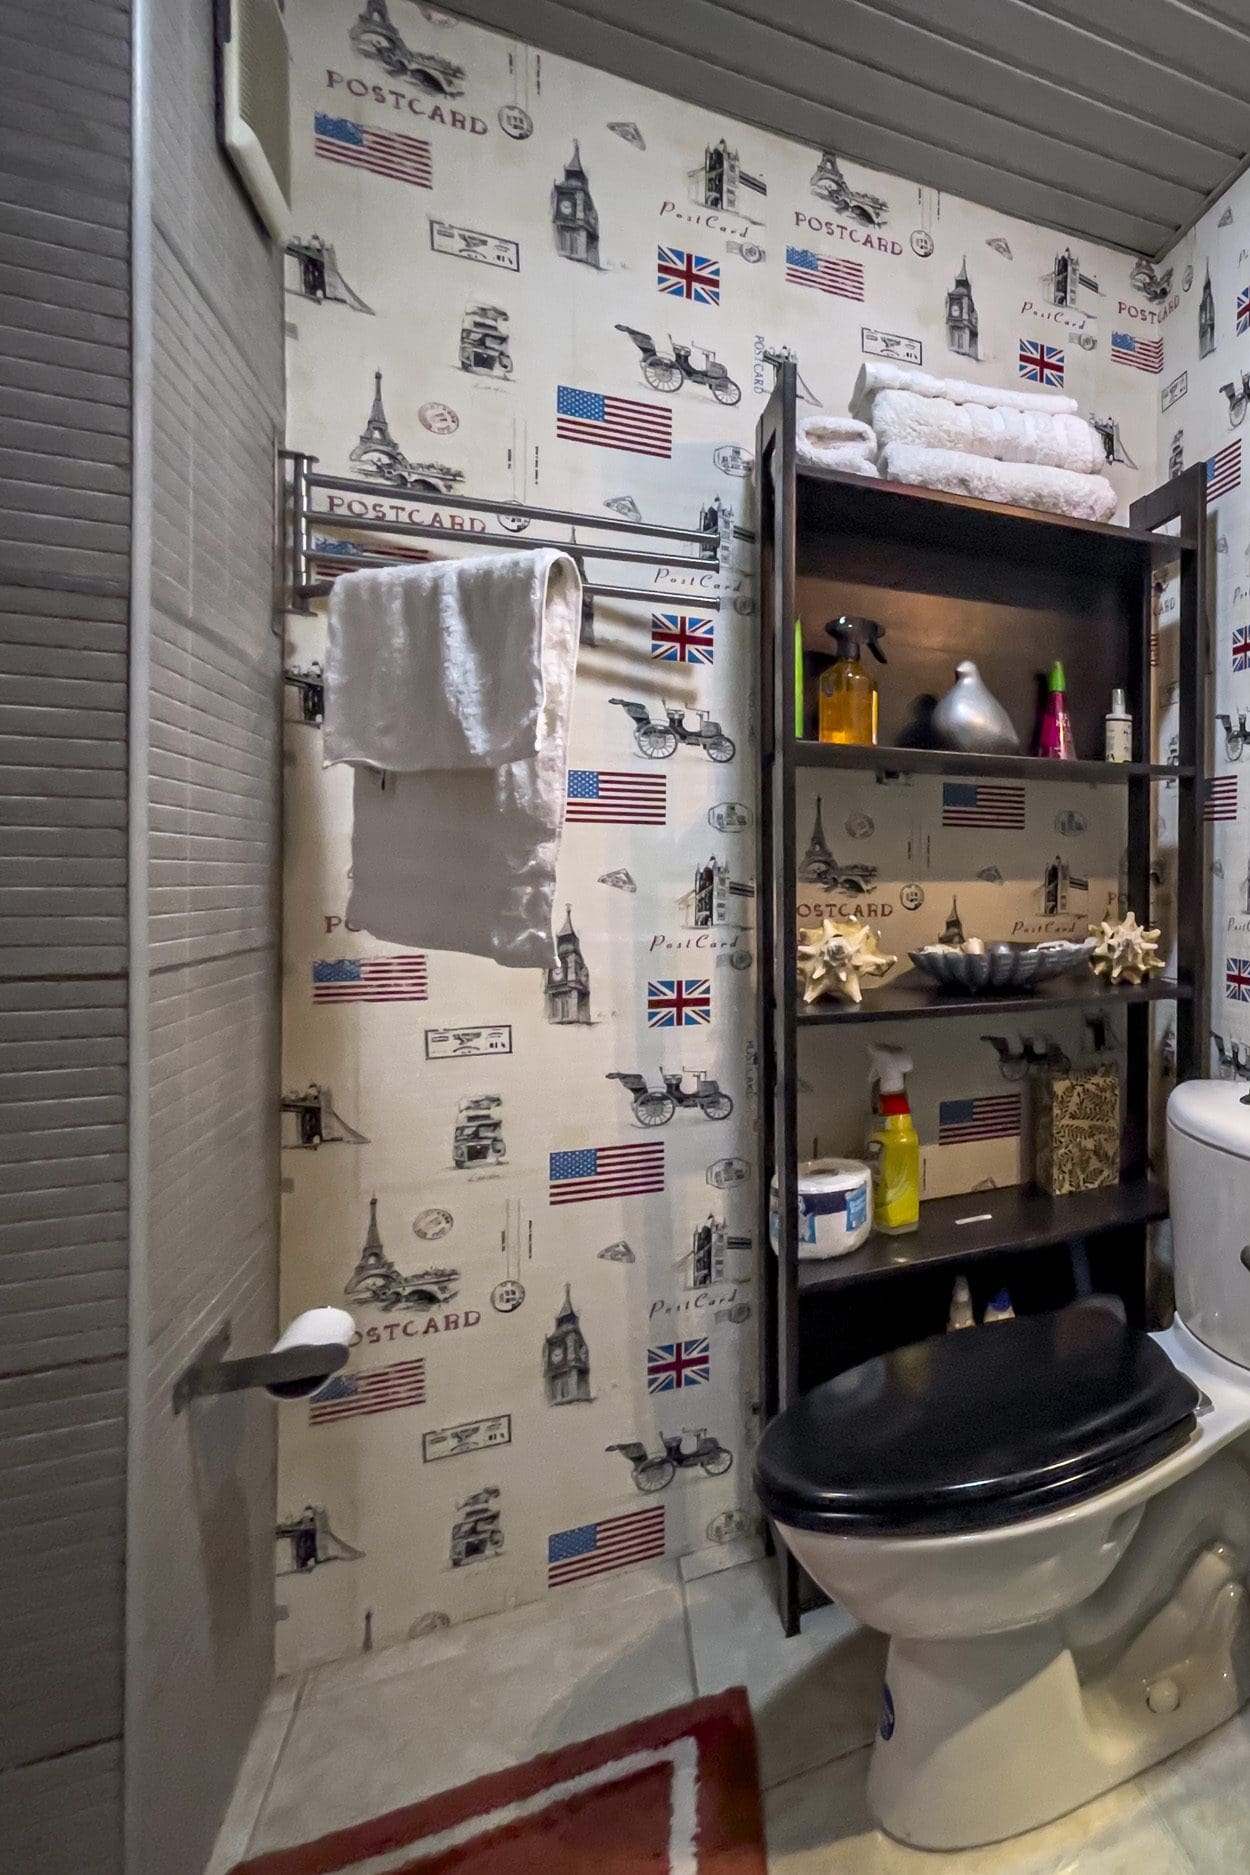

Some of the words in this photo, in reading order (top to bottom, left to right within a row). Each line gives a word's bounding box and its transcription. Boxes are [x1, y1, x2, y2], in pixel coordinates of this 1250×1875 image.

[326, 69, 489, 135] POSTCARD
[793, 211, 904, 256] POSTCARD
[1117, 295, 1180, 324] POSTCARD
[327, 495, 487, 533] POSTCARD
[650, 935, 738, 951] PostCard
